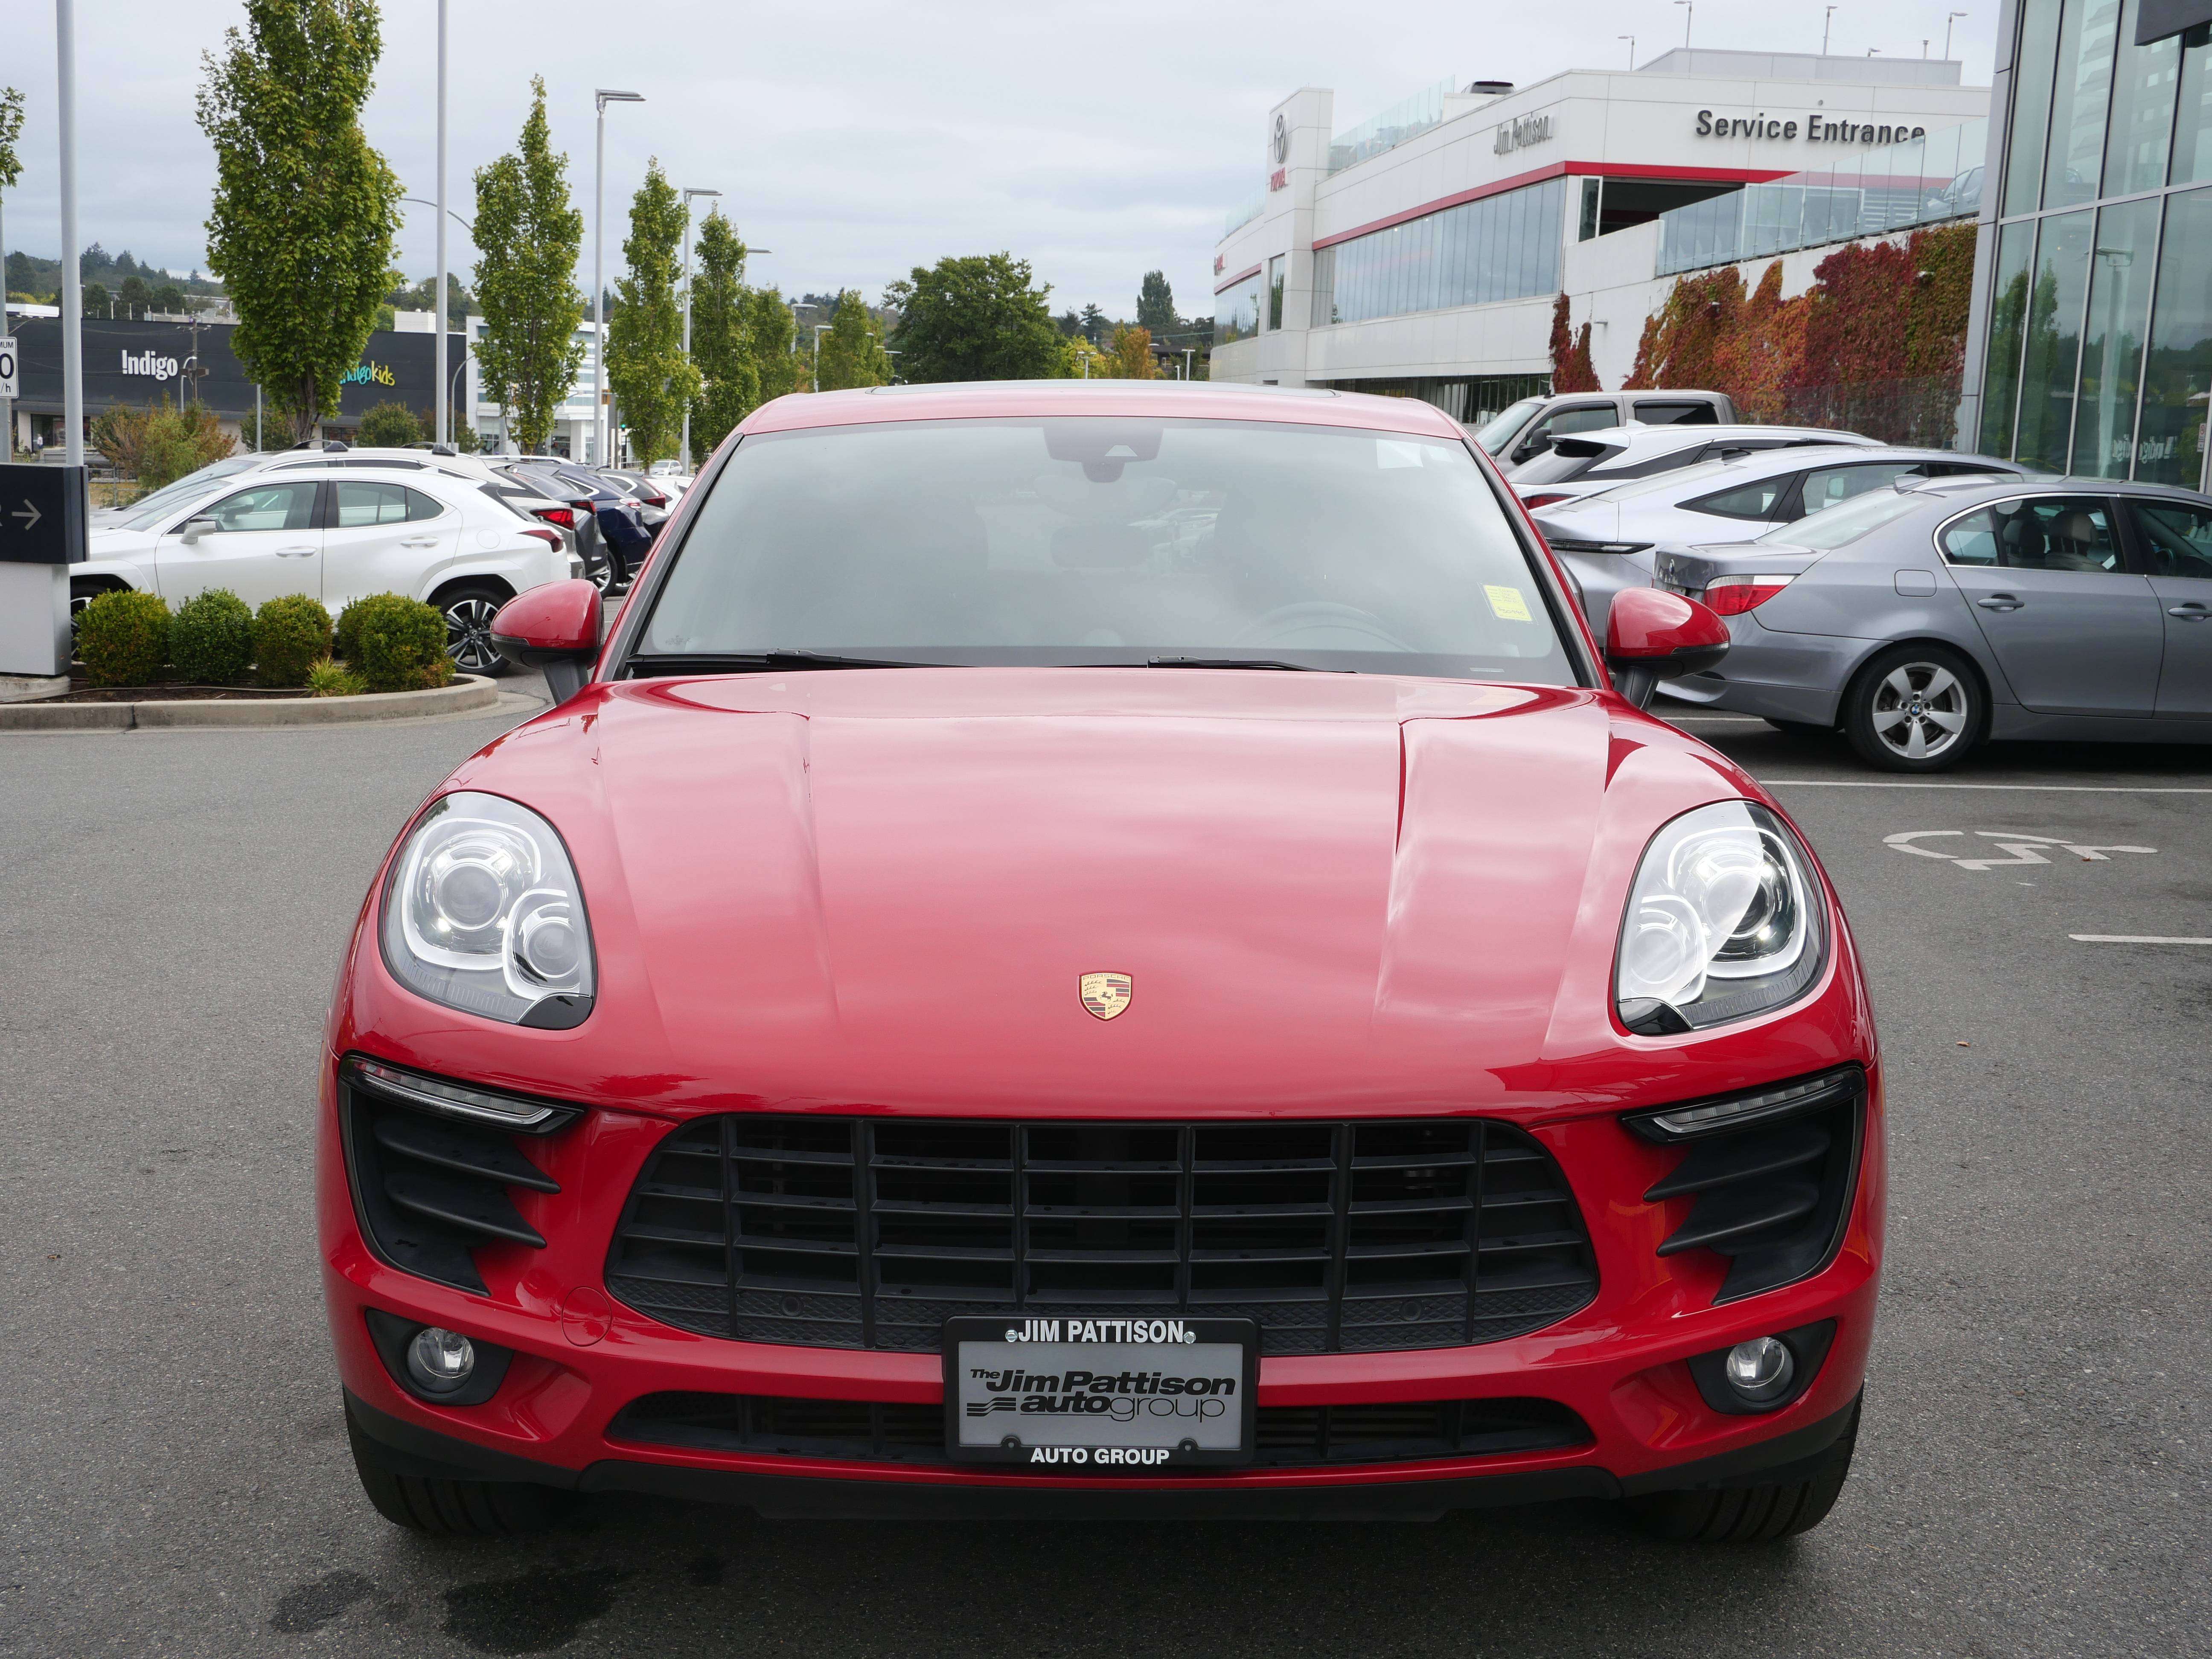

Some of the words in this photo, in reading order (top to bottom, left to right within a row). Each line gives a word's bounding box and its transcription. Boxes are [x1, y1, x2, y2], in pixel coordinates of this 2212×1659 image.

[1494, 124, 1509, 154] Jim
[1512, 112, 1549, 148] Pattison
[1696, 110, 1797, 140] Service
[1807, 115, 1925, 144] Entrance
[1018, 1320, 1059, 1342] JIM
[1068, 1321, 1183, 1343] PATTISON
[970, 1369, 1000, 1379] The
[986, 1370, 1060, 1392] Jim
[1061, 1371, 1235, 1395] Pattison
[1030, 1448, 1088, 1464] AUTO
[1094, 1449, 1170, 1465] GROUP
